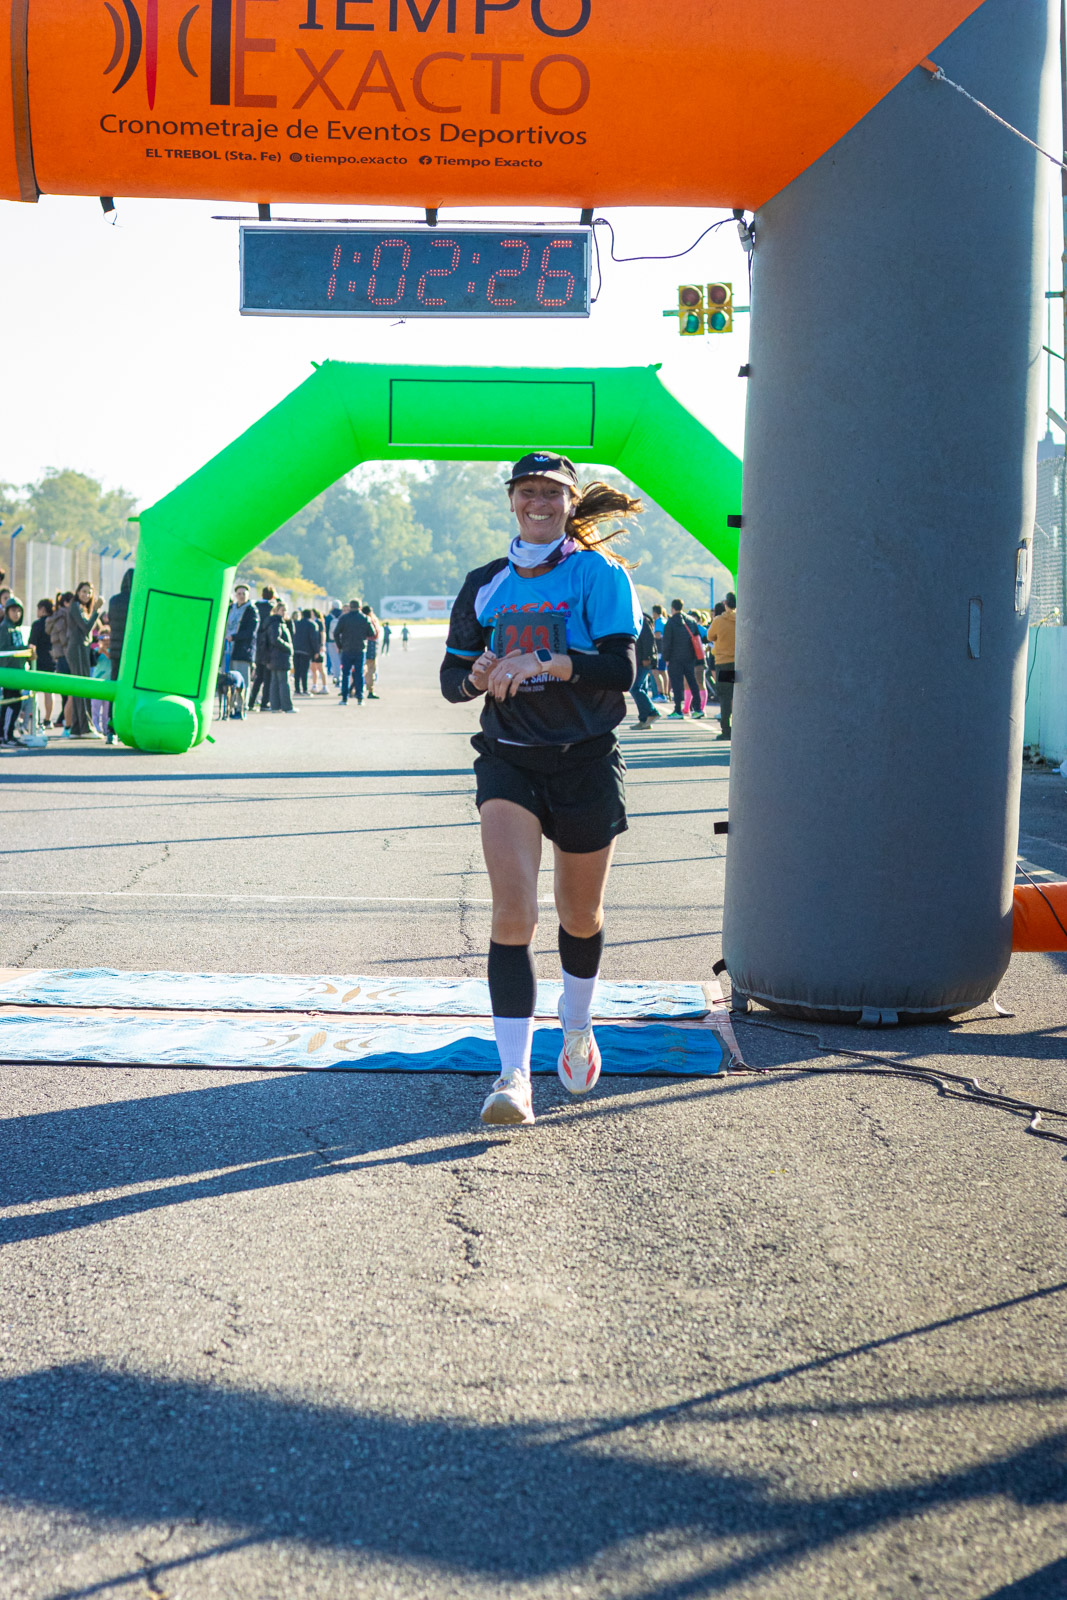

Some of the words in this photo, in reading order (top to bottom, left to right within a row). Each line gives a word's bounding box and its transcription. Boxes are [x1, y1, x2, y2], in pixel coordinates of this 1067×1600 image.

[99, 114, 279, 143] Cronometraje
[286, 118, 319, 139] de
[327, 120, 431, 142] Eventos
[440, 123, 587, 148] Deportivos
[145, 148, 163, 158] EL
[164, 148, 222, 160] TREBOL
[224, 150, 257, 162] (Sta.
[260, 151, 282, 163] Fe)
[304, 153, 408, 166] tiempo.exacto
[434, 155, 491, 168] Tiempo
[494, 157, 543, 168] Exacto
[327, 239, 575, 307] 1:02:26
[505, 625, 550, 655] 243
